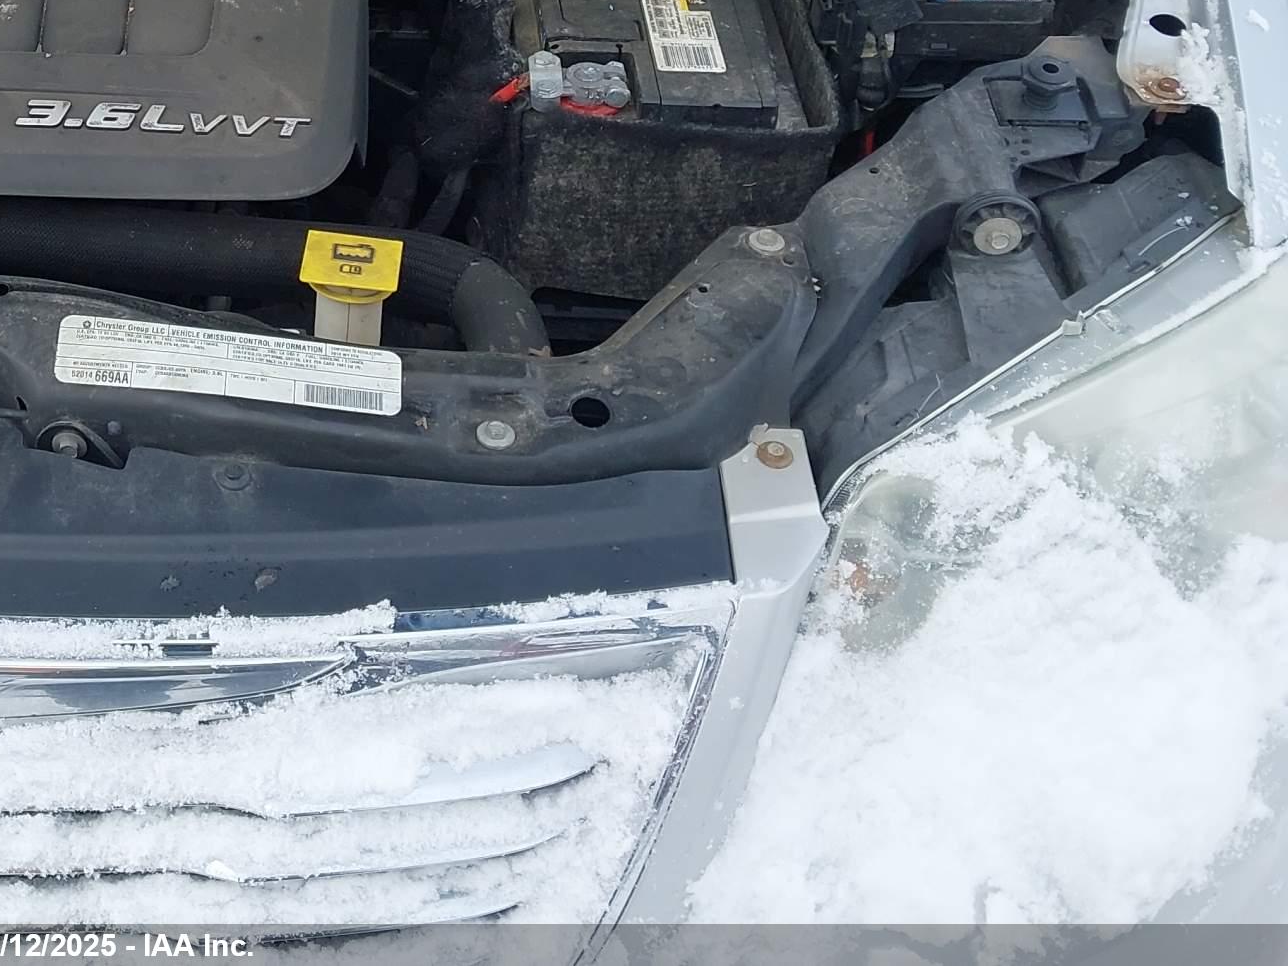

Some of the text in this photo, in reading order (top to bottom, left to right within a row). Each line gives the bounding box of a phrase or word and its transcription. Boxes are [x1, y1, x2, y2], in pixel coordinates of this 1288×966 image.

[189, 113, 312, 138] VVT
[96, 321, 165, 335] Chrysler Group LLC
[171, 329, 201, 339] VEHICLE
[202, 332, 237, 343] EMISSION
[239, 335, 272, 348] CONTROL
[274, 339, 324, 354] INFORMATION
[94, 370, 129, 384] 669AA
